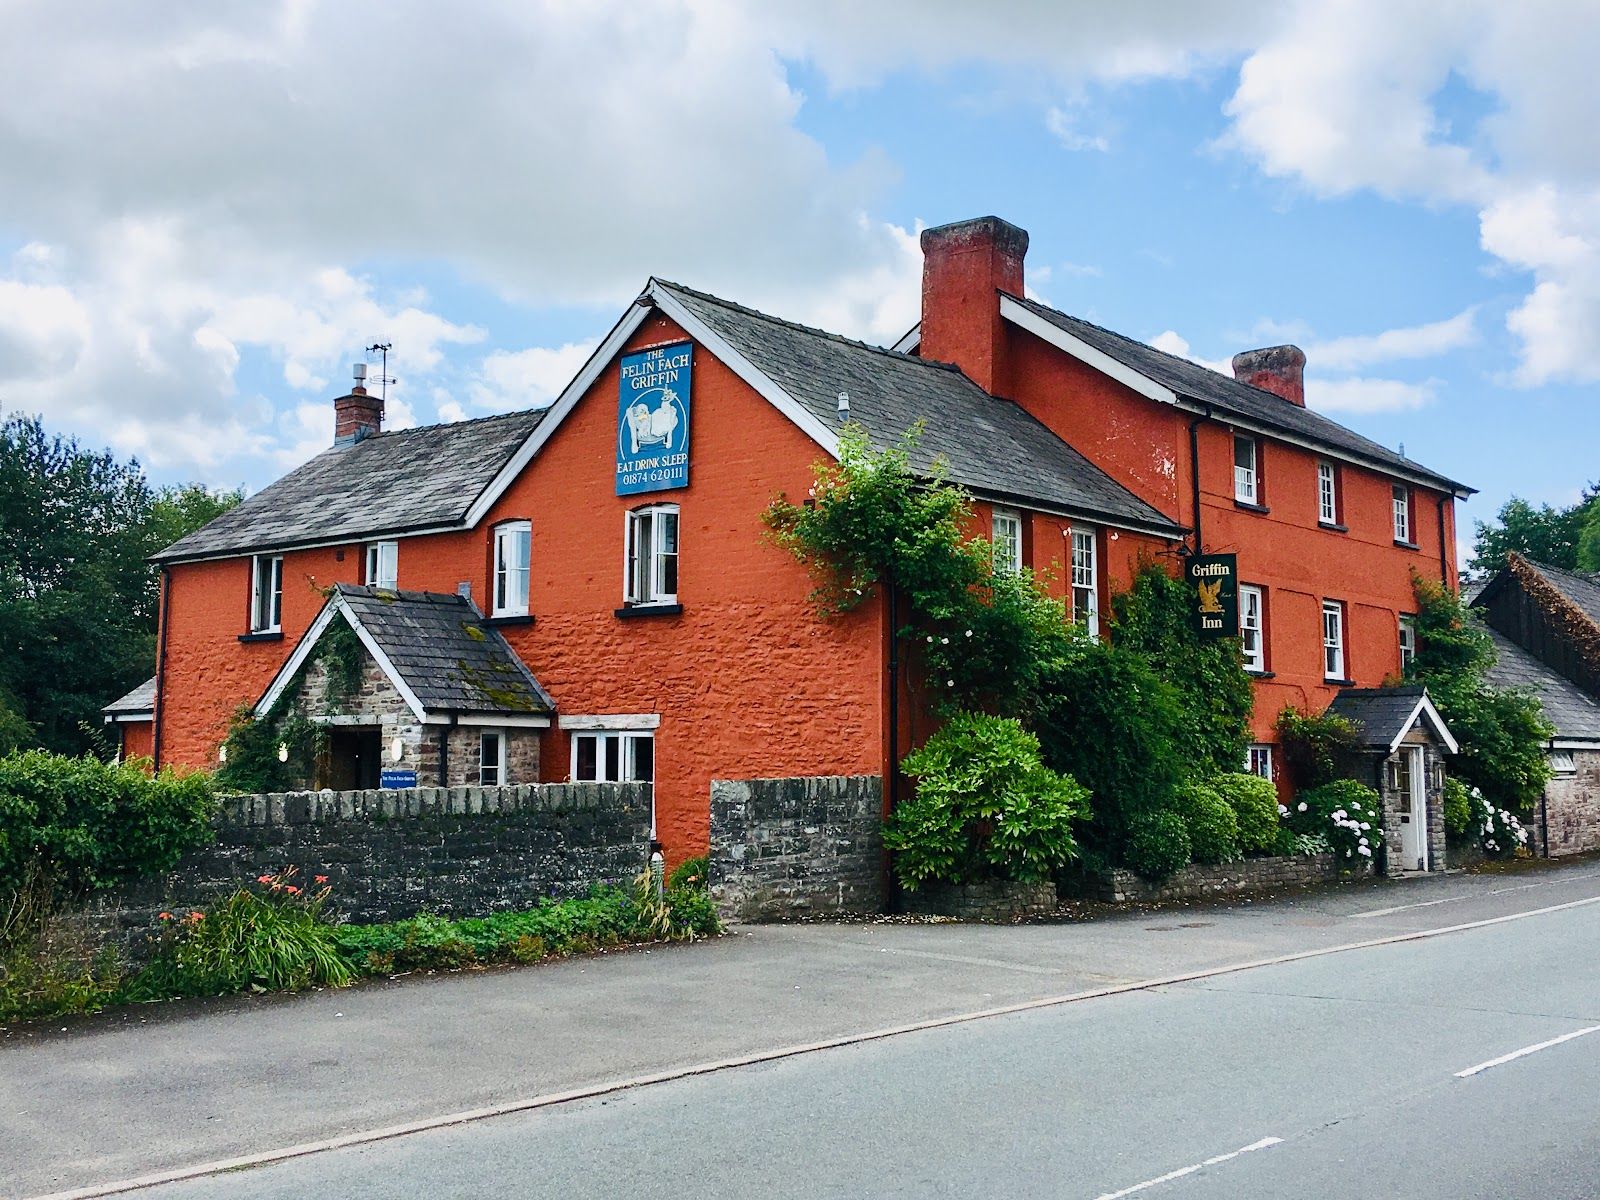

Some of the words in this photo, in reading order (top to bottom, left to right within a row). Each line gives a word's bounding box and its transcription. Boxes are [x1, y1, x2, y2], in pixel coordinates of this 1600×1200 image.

[646, 349, 664, 361] THE
[622, 361, 655, 379] FELIN
[658, 354, 689, 370] FACH
[631, 370, 678, 389] GRIFFIN
[617, 461, 634, 474] EAT
[635, 456, 660, 472] DRINK
[662, 453, 688, 466] SLEEP
[623, 472, 648, 485] 01874
[650, 467, 683, 481] 620111
[1192, 564, 1230, 576] Griffin
[1202, 616, 1222, 628] Inn
